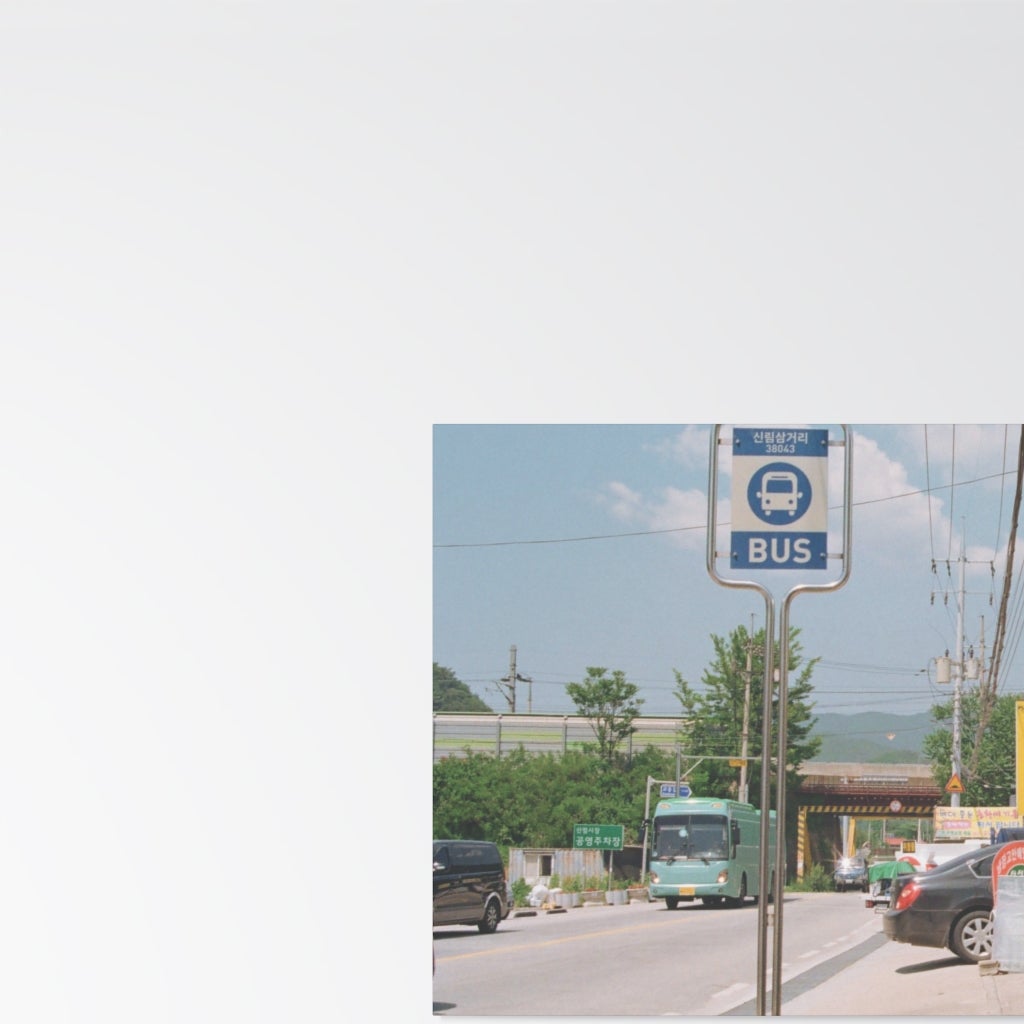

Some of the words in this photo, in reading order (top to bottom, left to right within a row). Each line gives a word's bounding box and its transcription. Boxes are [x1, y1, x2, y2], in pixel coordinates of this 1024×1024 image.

[753, 432, 808, 444] 신림삼거리
[766, 445, 795, 453] 38043
[748, 538, 812, 564] BUS
[576, 836, 621, 848] 공영주차장
